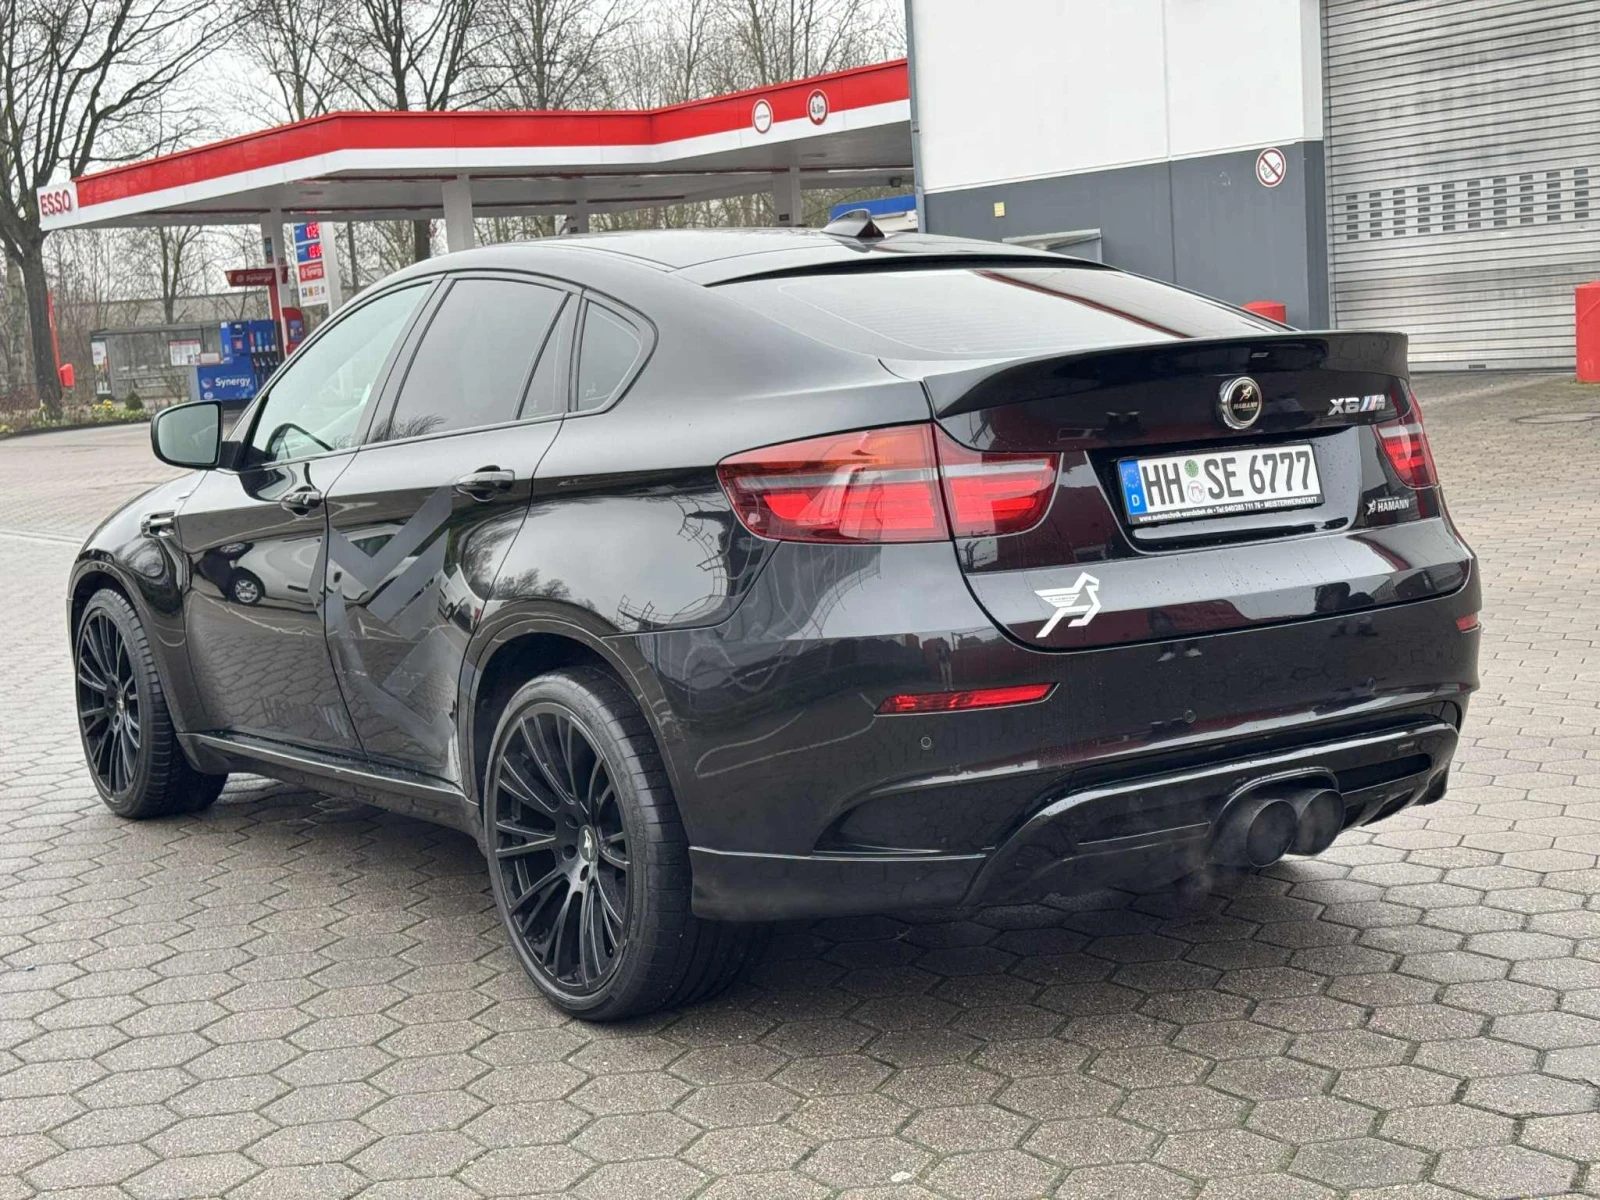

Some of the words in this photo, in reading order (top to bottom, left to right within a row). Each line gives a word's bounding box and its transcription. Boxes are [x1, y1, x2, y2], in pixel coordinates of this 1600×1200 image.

[40, 189, 72, 216] ESSO
[215, 377, 250, 388] Synergy
[1141, 463, 1186, 506] HH
[1204, 457, 1244, 499] SE
[1249, 450, 1311, 495] 6777
[1132, 494, 1140, 507] D
[1263, 496, 1318, 508] MEISTERWERKSTATT
[1377, 497, 1410, 513] HAMANN
